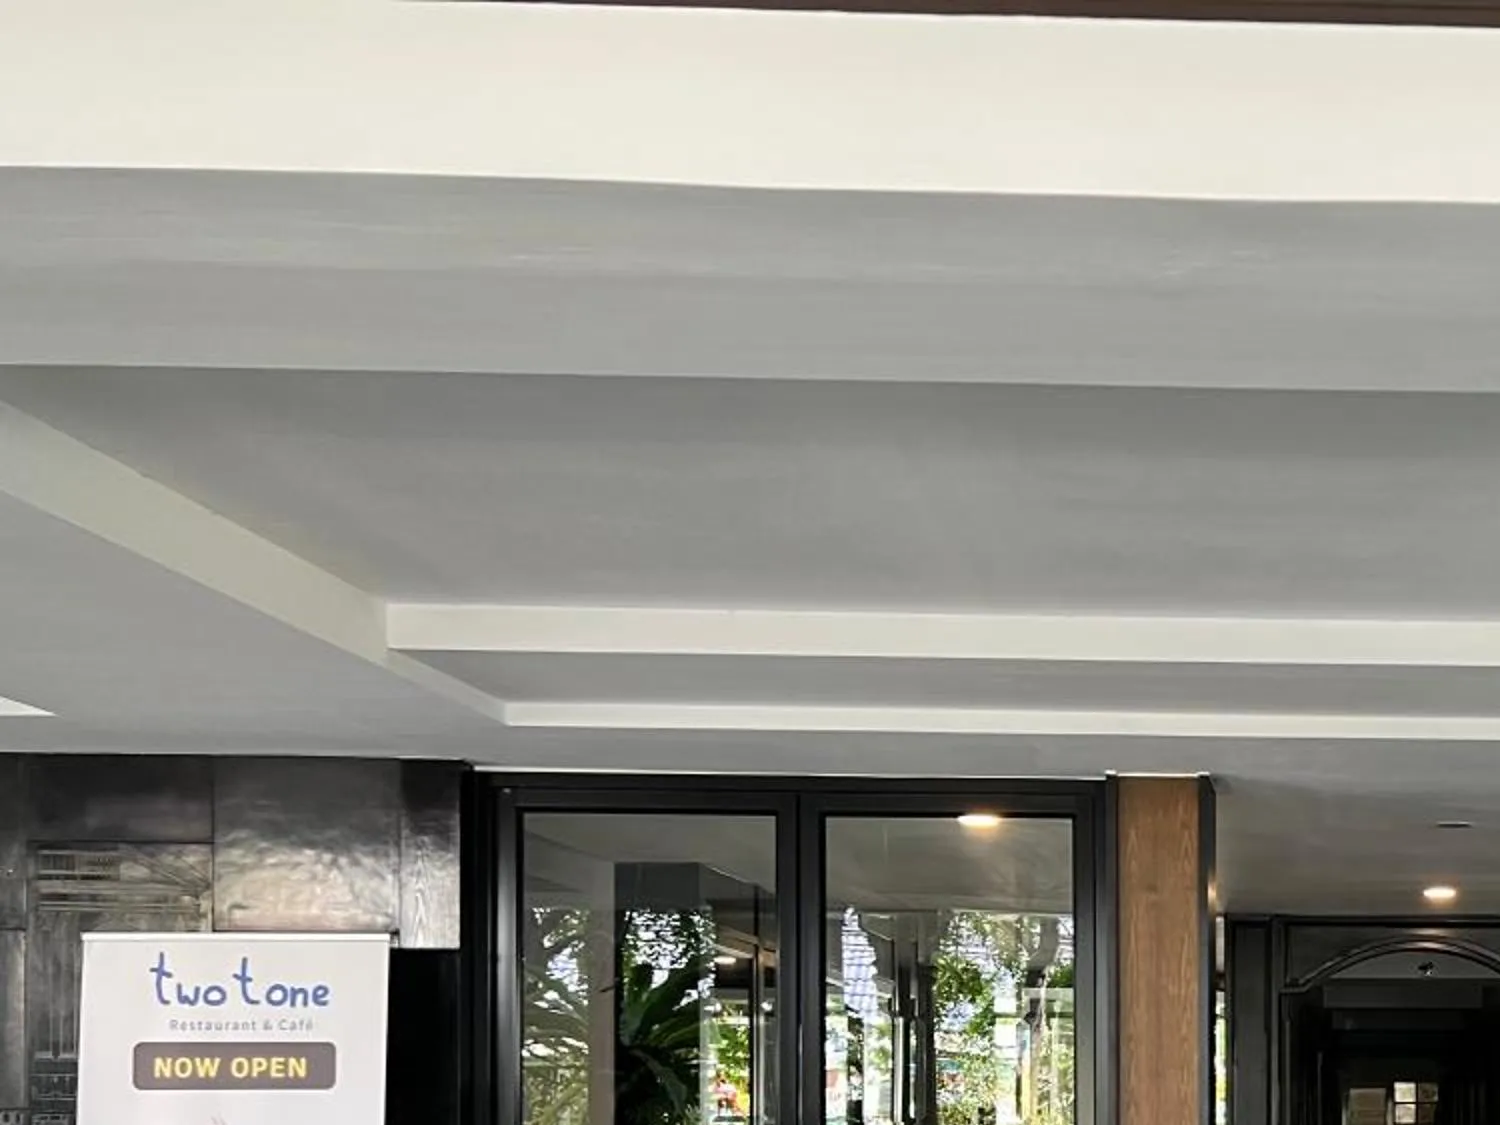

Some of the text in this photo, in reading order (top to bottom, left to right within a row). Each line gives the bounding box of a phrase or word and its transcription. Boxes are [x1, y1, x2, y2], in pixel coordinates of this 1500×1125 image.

[149, 952, 330, 1008] two tone
[169, 1018, 256, 1032] Restaurant
[262, 1018, 274, 1032] &
[153, 1056, 307, 1079] NOW OPEN
